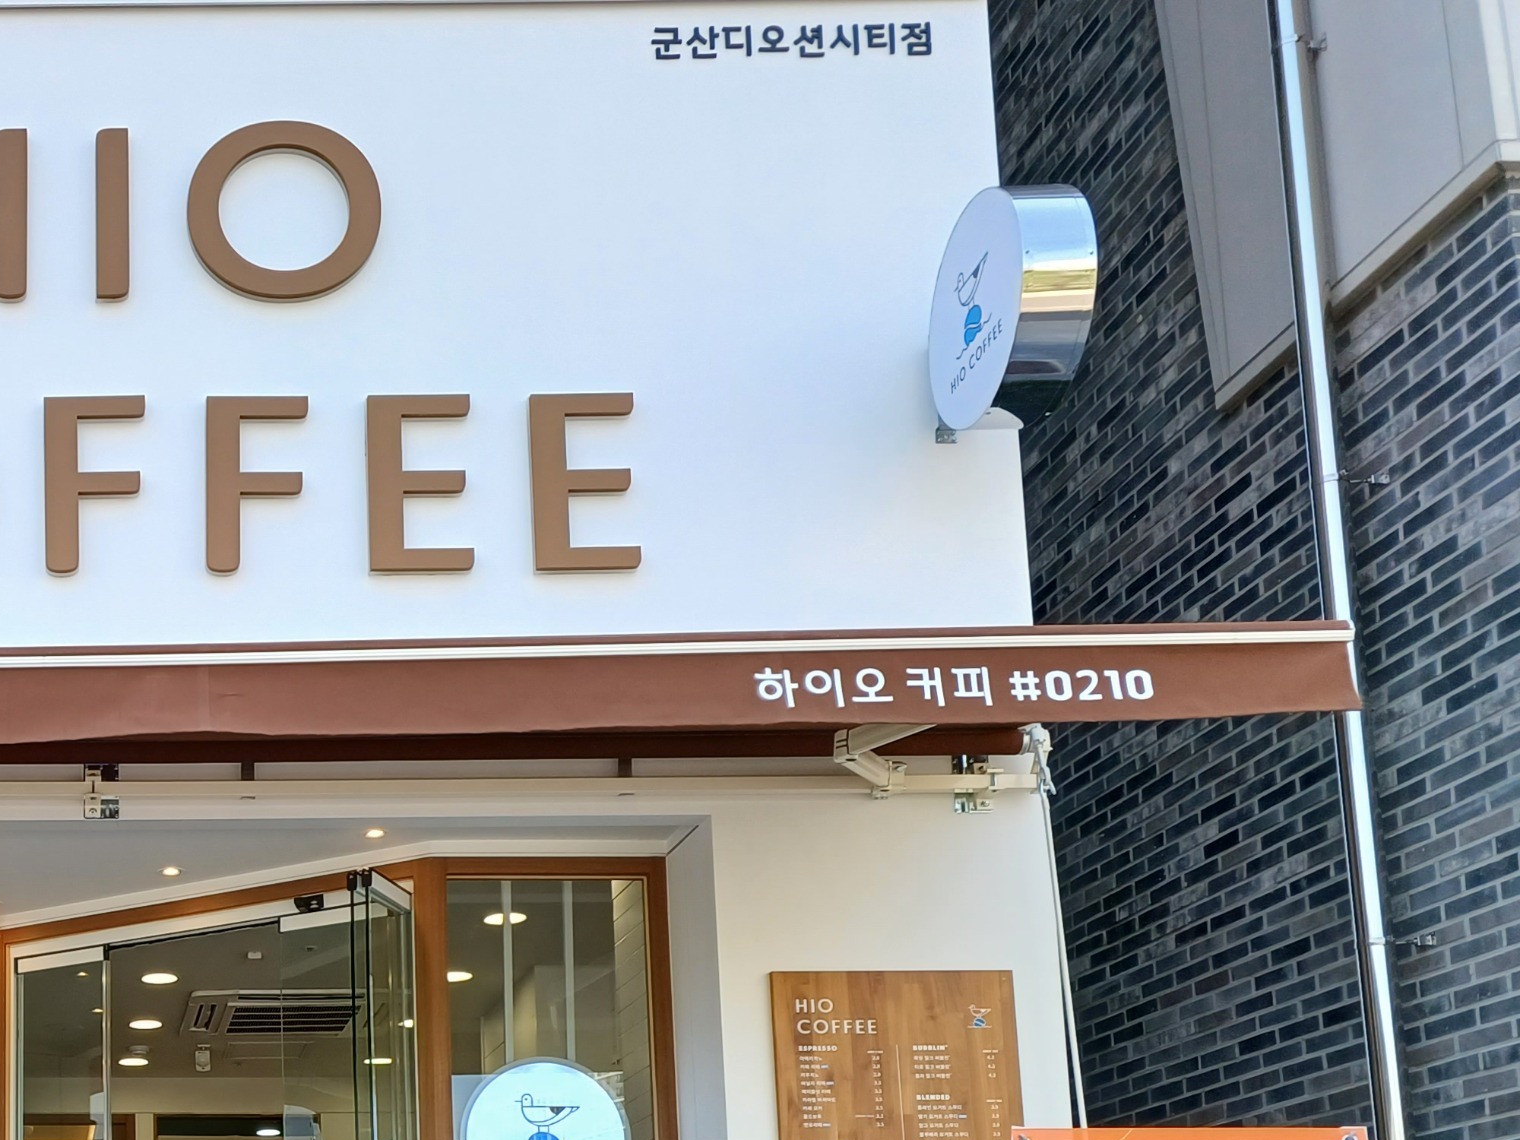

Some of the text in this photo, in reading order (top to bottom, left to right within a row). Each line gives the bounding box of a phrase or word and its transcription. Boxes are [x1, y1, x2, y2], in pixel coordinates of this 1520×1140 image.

[651, 21, 932, 60] 군산디오션시티점
[950, 318, 1003, 394] HIO COFFEE
[754, 666, 1154, 708] 하이오 커피 #0210
[795, 999, 833, 1014] HIO
[797, 1019, 877, 1035] COFFEE
